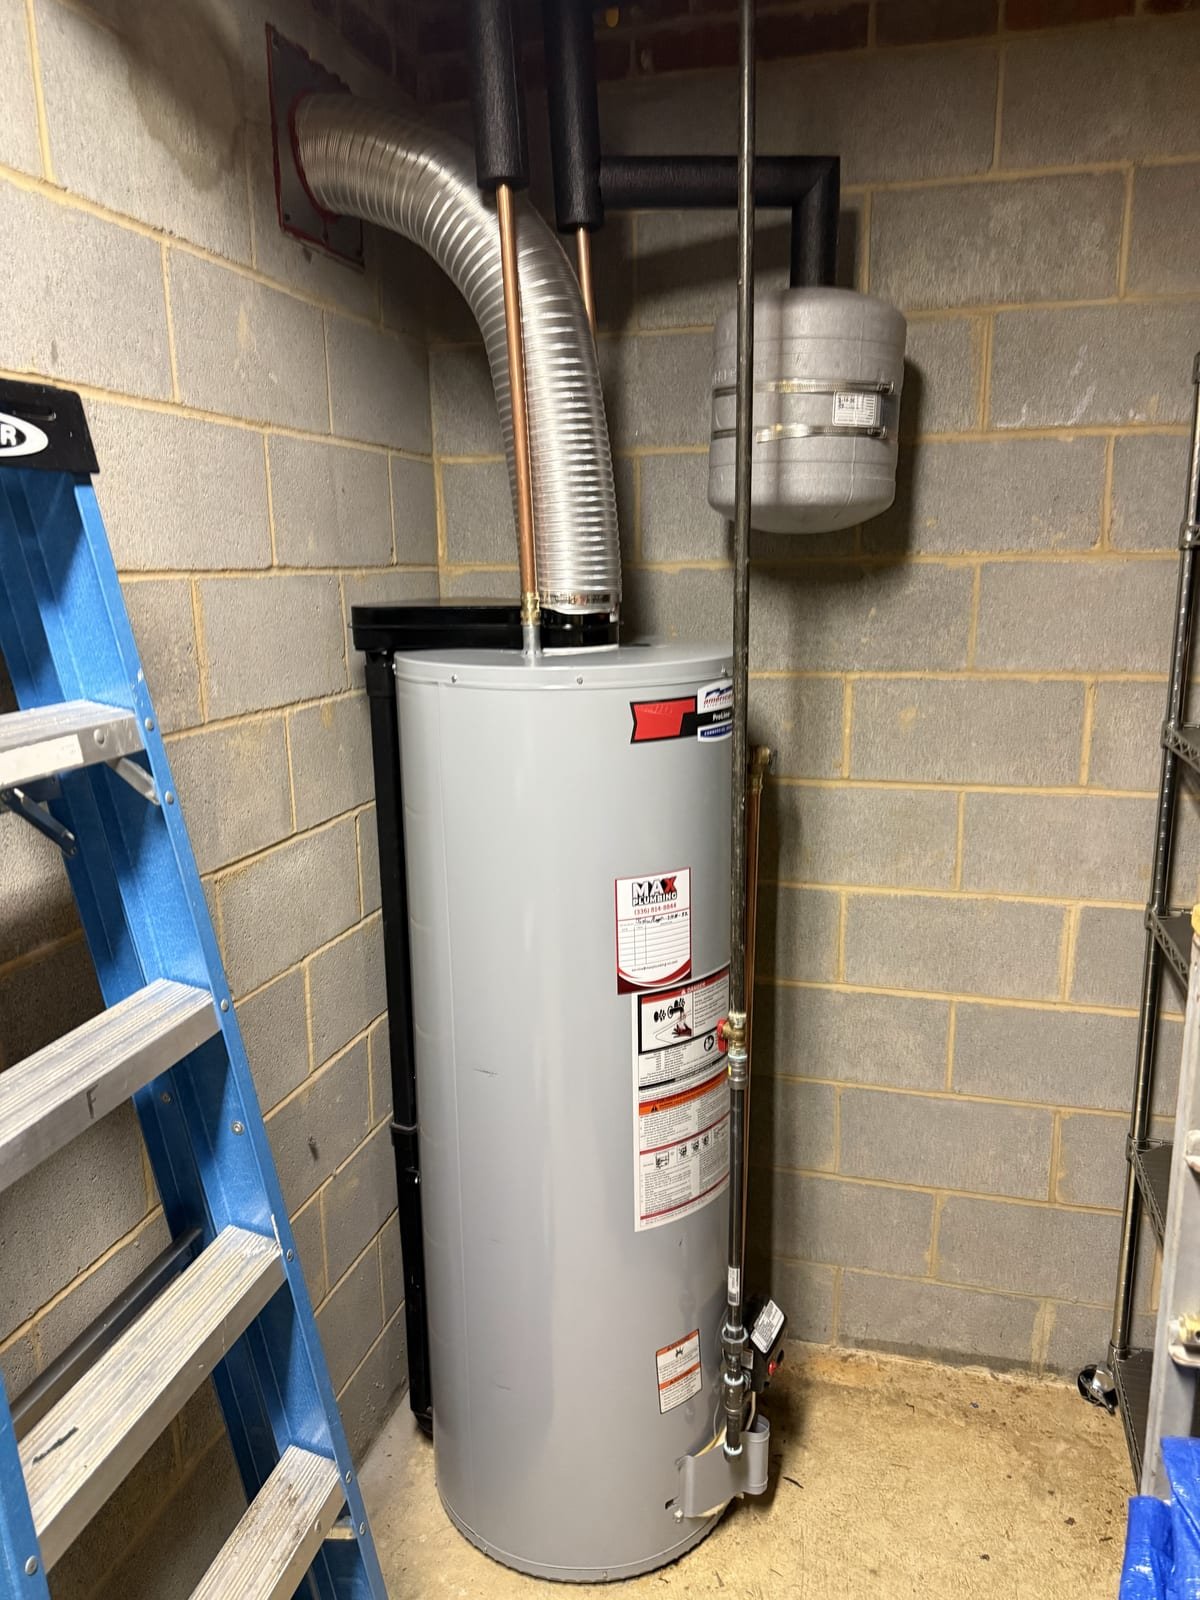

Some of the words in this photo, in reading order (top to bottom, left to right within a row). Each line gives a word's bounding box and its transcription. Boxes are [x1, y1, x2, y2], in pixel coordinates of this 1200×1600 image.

[713, 711, 730, 721] ProLine
[632, 876, 677, 898] MAX
[632, 892, 677, 907] PLUMBING
